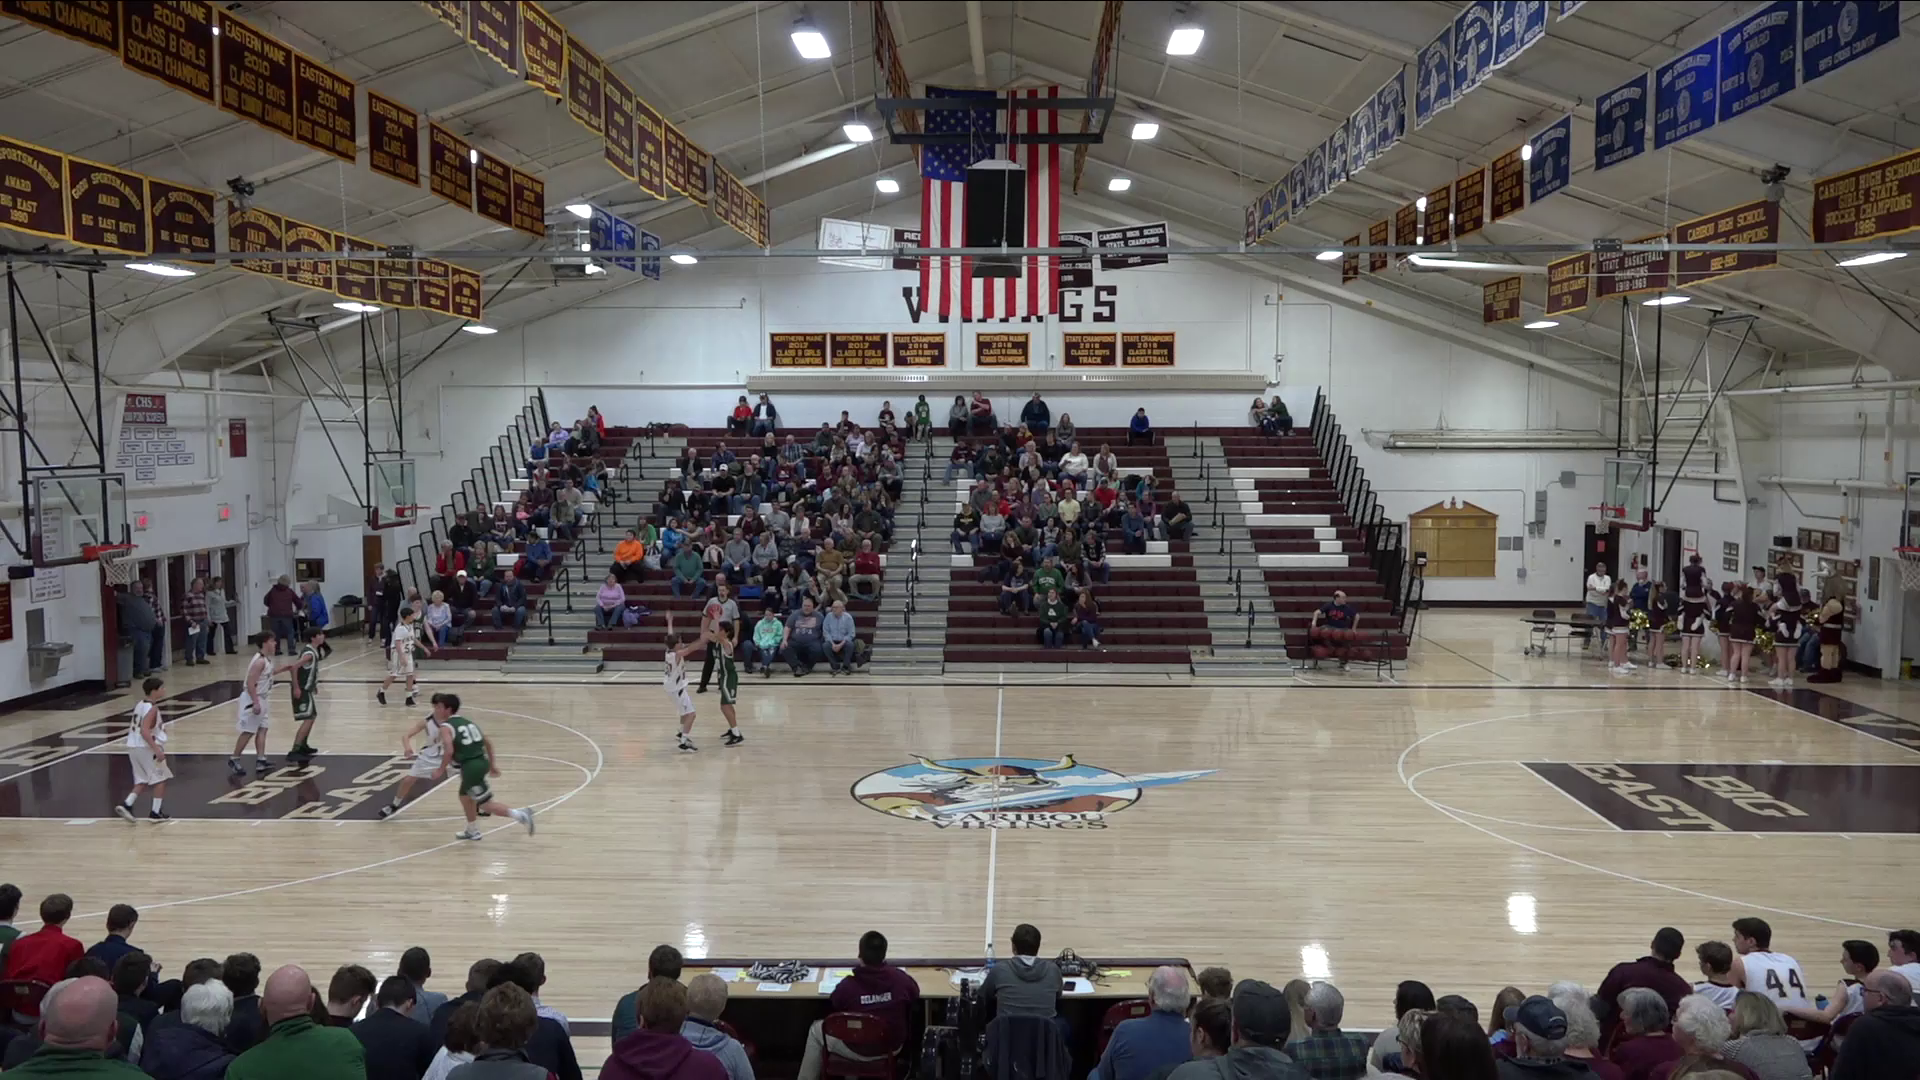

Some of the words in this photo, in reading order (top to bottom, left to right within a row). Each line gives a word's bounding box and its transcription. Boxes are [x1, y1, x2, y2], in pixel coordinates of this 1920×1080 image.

[153, 3, 185, 33] 2010
[131, 14, 166, 48] CLASS
[169, 33, 177, 54] B
[180, 38, 206, 69] GIRLS
[224, 20, 262, 53] EASTERN
[263, 41, 287, 67] MAINE
[1744, 30, 1770, 55] AWARD
[1803, 27, 1827, 52] NORTH
[1852, 32, 1878, 55] COUNTRY
[127, 39, 163, 72] SOCCER
[165, 55, 210, 92] CHAMPIONS
[244, 51, 271, 77] 2010
[229, 64, 257, 93] CLASS
[266, 82, 287, 107] BOYS
[299, 62, 333, 91] EASTERN
[333, 79, 352, 102] MAINE
[303, 99, 327, 126] CLASS
[5, 175, 32, 193] AWARD
[1818, 176, 1857, 201] CARIBOU
[1858, 169, 1884, 190] HIGH
[1838, 189, 1866, 209] GIRLS
[1869, 180, 1900, 202] STATE
[17, 197, 38, 214] EAST
[1825, 207, 1857, 228] SOCCER
[1859, 191, 1913, 220] CHAMPIONS
[98, 216, 118, 231] EAST
[1099, 231, 1124, 240] CARIBOU
[1143, 227, 1165, 236] SCHOOL
[1687, 222, 1716, 242] CARIBOU
[1718, 215, 1735, 233] HIGH
[1737, 207, 1767, 228] SCHOOL
[1729, 225, 1769, 244] CHAMPIONS
[1127, 236, 1160, 246] CHAMPIONS
[1602, 258, 1620, 273] STATE
[1624, 251, 1665, 269] BASKETBALL
[776, 349, 796, 357] CLASS
[836, 349, 857, 357] CLASS
[906, 356, 932, 364] TENNIS
[1079, 356, 1102, 364] TRACK
[1126, 356, 1169, 364] BASKETBALL
[135, 396, 153, 408] CHS
[457, 723, 484, 748] 30
[207, 764, 327, 806] BIG
[279, 755, 419, 820] EAST
[1567, 762, 1733, 831] EAST
[1683, 775, 1809, 818] BIG
[930, 821, 1108, 830] VIKINGS
[931, 812, 1104, 823] CARIBOU
[1765, 967, 1806, 999] 44
